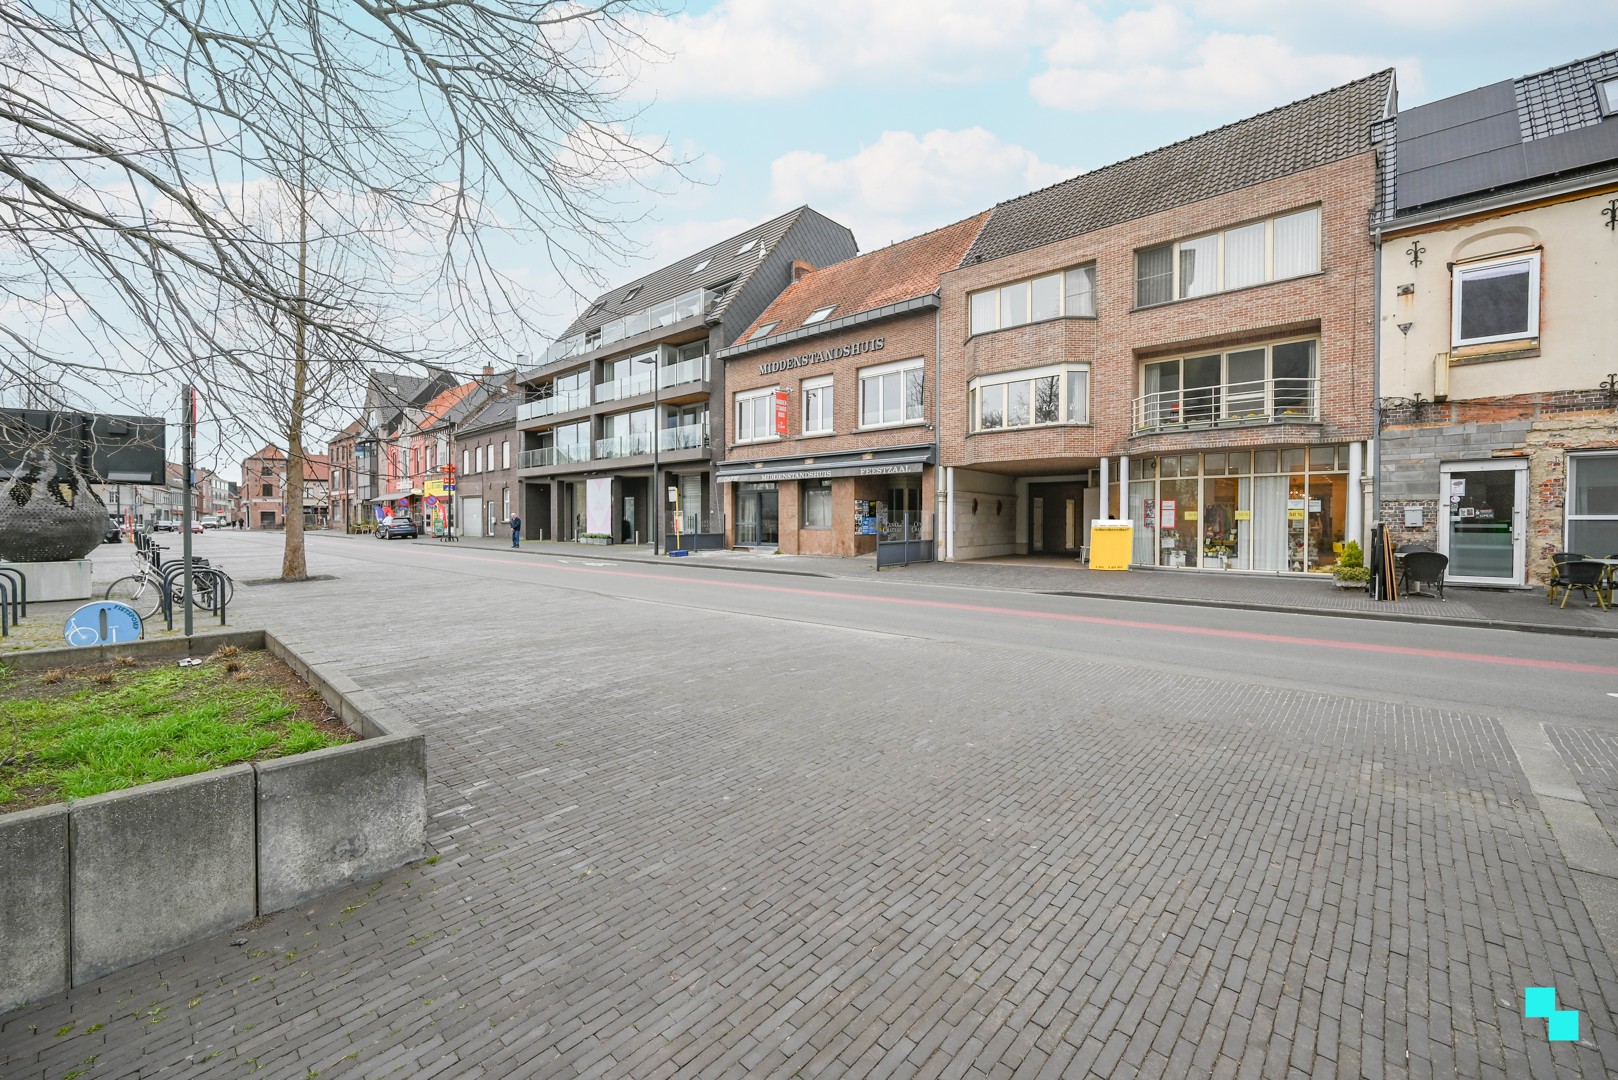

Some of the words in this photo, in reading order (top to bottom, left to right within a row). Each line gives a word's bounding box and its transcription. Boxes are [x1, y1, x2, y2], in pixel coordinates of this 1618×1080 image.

[759, 337, 885, 375] MIDDENSTANDSHUIS
[761, 470, 832, 481] MIDDENSTANDSHUIS
[860, 465, 911, 475] FEESTZAAL
[114, 605, 138, 630] FIETSPOMP
